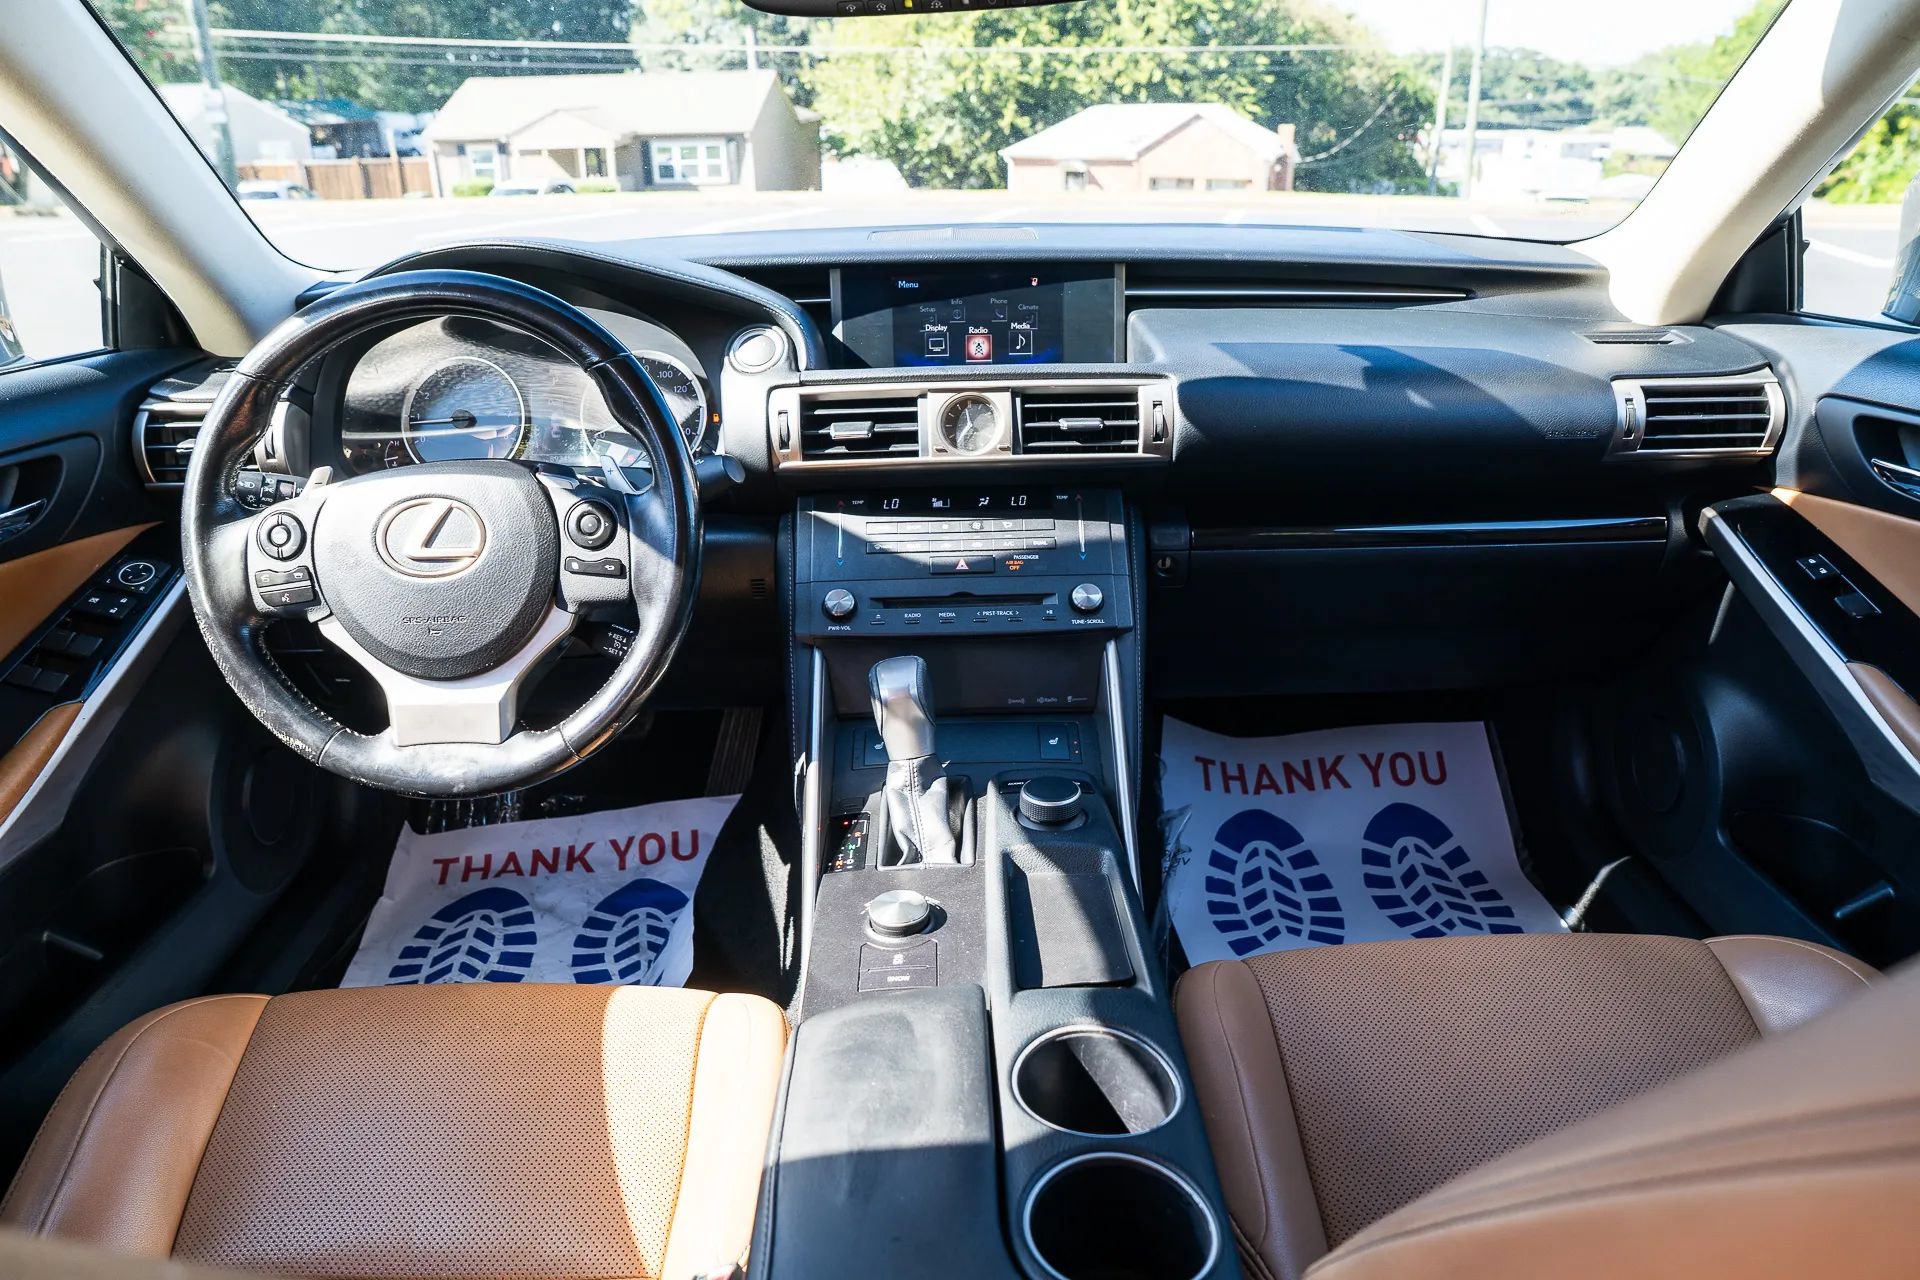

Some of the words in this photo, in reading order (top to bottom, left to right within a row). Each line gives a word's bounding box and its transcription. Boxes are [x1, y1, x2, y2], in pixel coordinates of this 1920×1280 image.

[898, 280, 919, 289] Menu
[919, 305, 936, 314] Setup
[1017, 303, 1040, 311] Climate
[925, 323, 948, 333] Display
[968, 326, 989, 334] Radio
[1010, 322, 1031, 330] Media
[658, 371, 674, 379] 100
[673, 385, 688, 393] 120
[424, 392, 431, 401] 2
[1194, 754, 1352, 796] THANK
[1358, 750, 1448, 787] YOU
[432, 842, 596, 886] THANK
[608, 829, 700, 871] YOU
